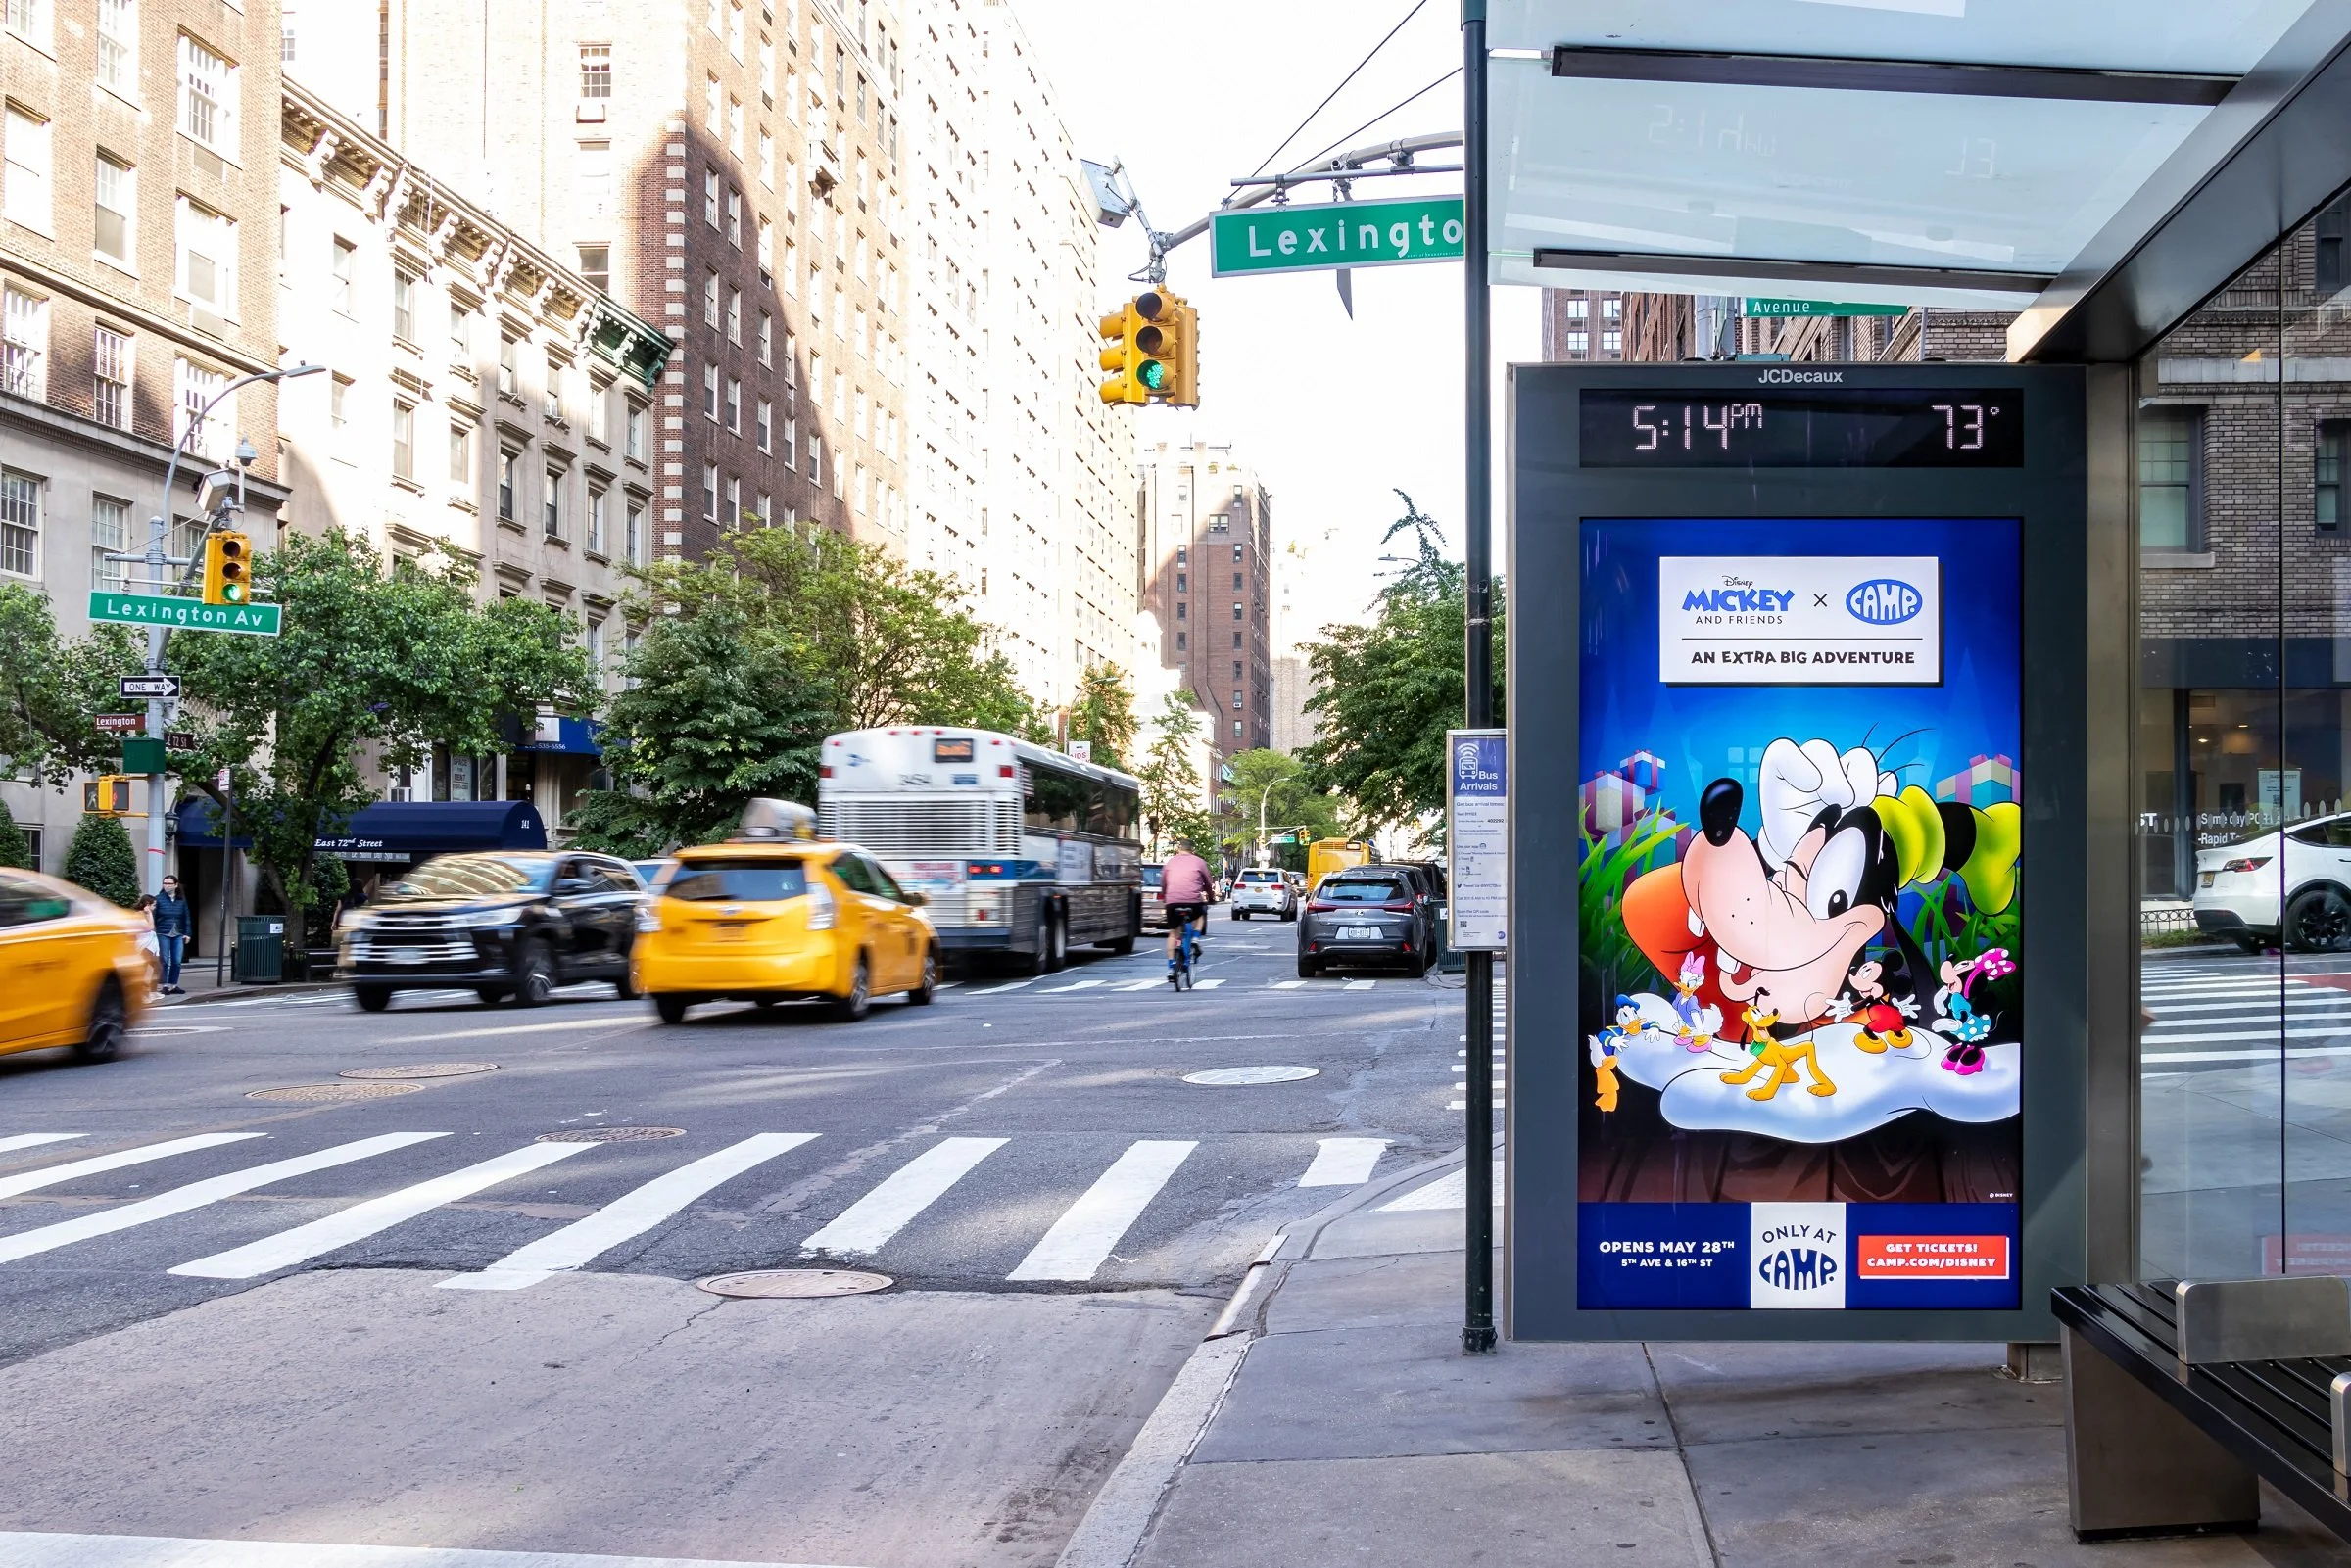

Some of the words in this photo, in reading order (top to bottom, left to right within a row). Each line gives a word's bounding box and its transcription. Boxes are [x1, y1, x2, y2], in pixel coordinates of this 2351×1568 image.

[1248, 214, 1463, 258] Lexingto
[1753, 301, 1810, 313] Avenue
[1758, 369, 1844, 383] JCDecaux
[1721, 575, 1753, 589] Disney
[1682, 589, 1795, 612] MICKEY
[107, 598, 227, 625] Lexington
[234, 610, 263, 627] Av
[1696, 616, 1722, 625] AND
[1729, 615, 1783, 624] FRIENDS
[1691, 651, 1715, 664] AN
[1722, 650, 1777, 664] EXTRA
[1781, 651, 1807, 664] BIG
[1812, 651, 1915, 664] ADVENTURE
[128, 683, 147, 691] ONE
[154, 683, 171, 691] WAY
[96, 716, 136, 727] Lexington
[1479, 770, 1498, 780] Bus
[1460, 782, 1498, 791] Arrivals
[521, 820, 530, 829] 141
[338, 838, 356, 847] 72nd
[357, 839, 383, 848] Street
[1762, 1224, 1810, 1243] ONLY
[1813, 1227, 1837, 1244] AT
[1599, 1241, 1654, 1253] OPENS
[1660, 1241, 1696, 1253] MAY
[1702, 1240, 1735, 1253] 28TH
[1886, 1243, 1913, 1253] GET
[1916, 1243, 1978, 1253] TICKETS!
[1621, 1259, 1637, 1267] 5TH
[1640, 1259, 1661, 1267] AVE
[1665, 1259, 1673, 1267] &
[1676, 1259, 1697, 1267] 16TH
[1700, 1259, 1713, 1267] ST
[1866, 1257, 1997, 1269] CAMP.COM/DISNEY
